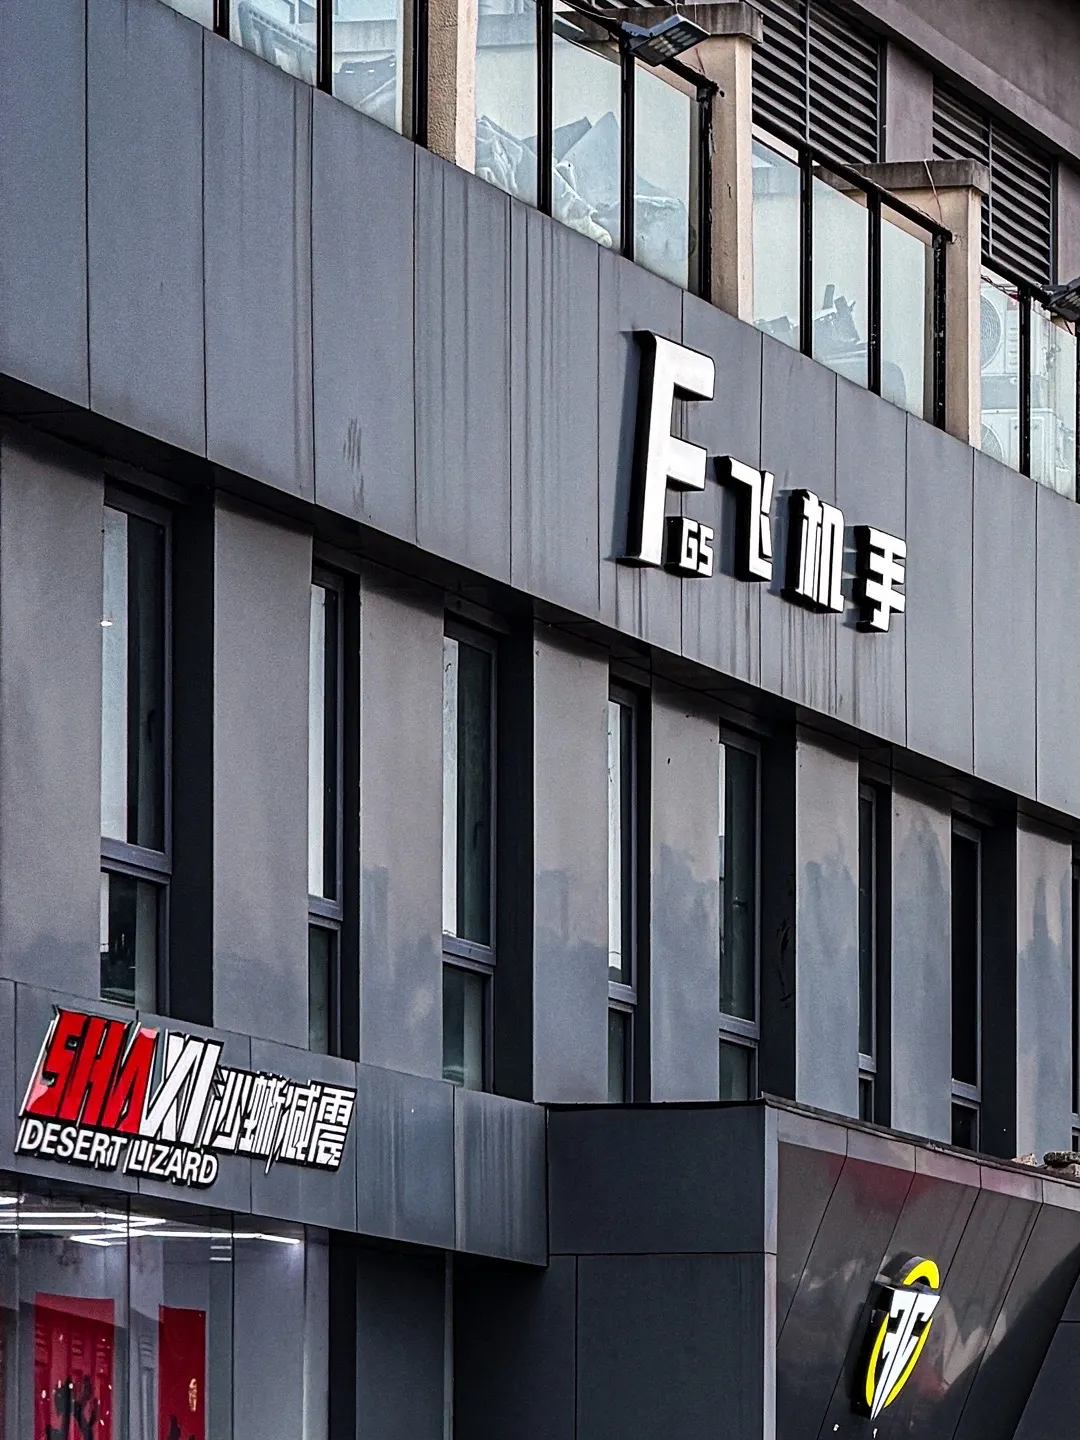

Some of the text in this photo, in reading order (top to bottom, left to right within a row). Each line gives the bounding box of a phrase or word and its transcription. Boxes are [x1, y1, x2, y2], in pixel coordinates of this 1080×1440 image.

[676, 517, 715, 578] GS
[18, 1118, 219, 1185] DESERT LIZARD
